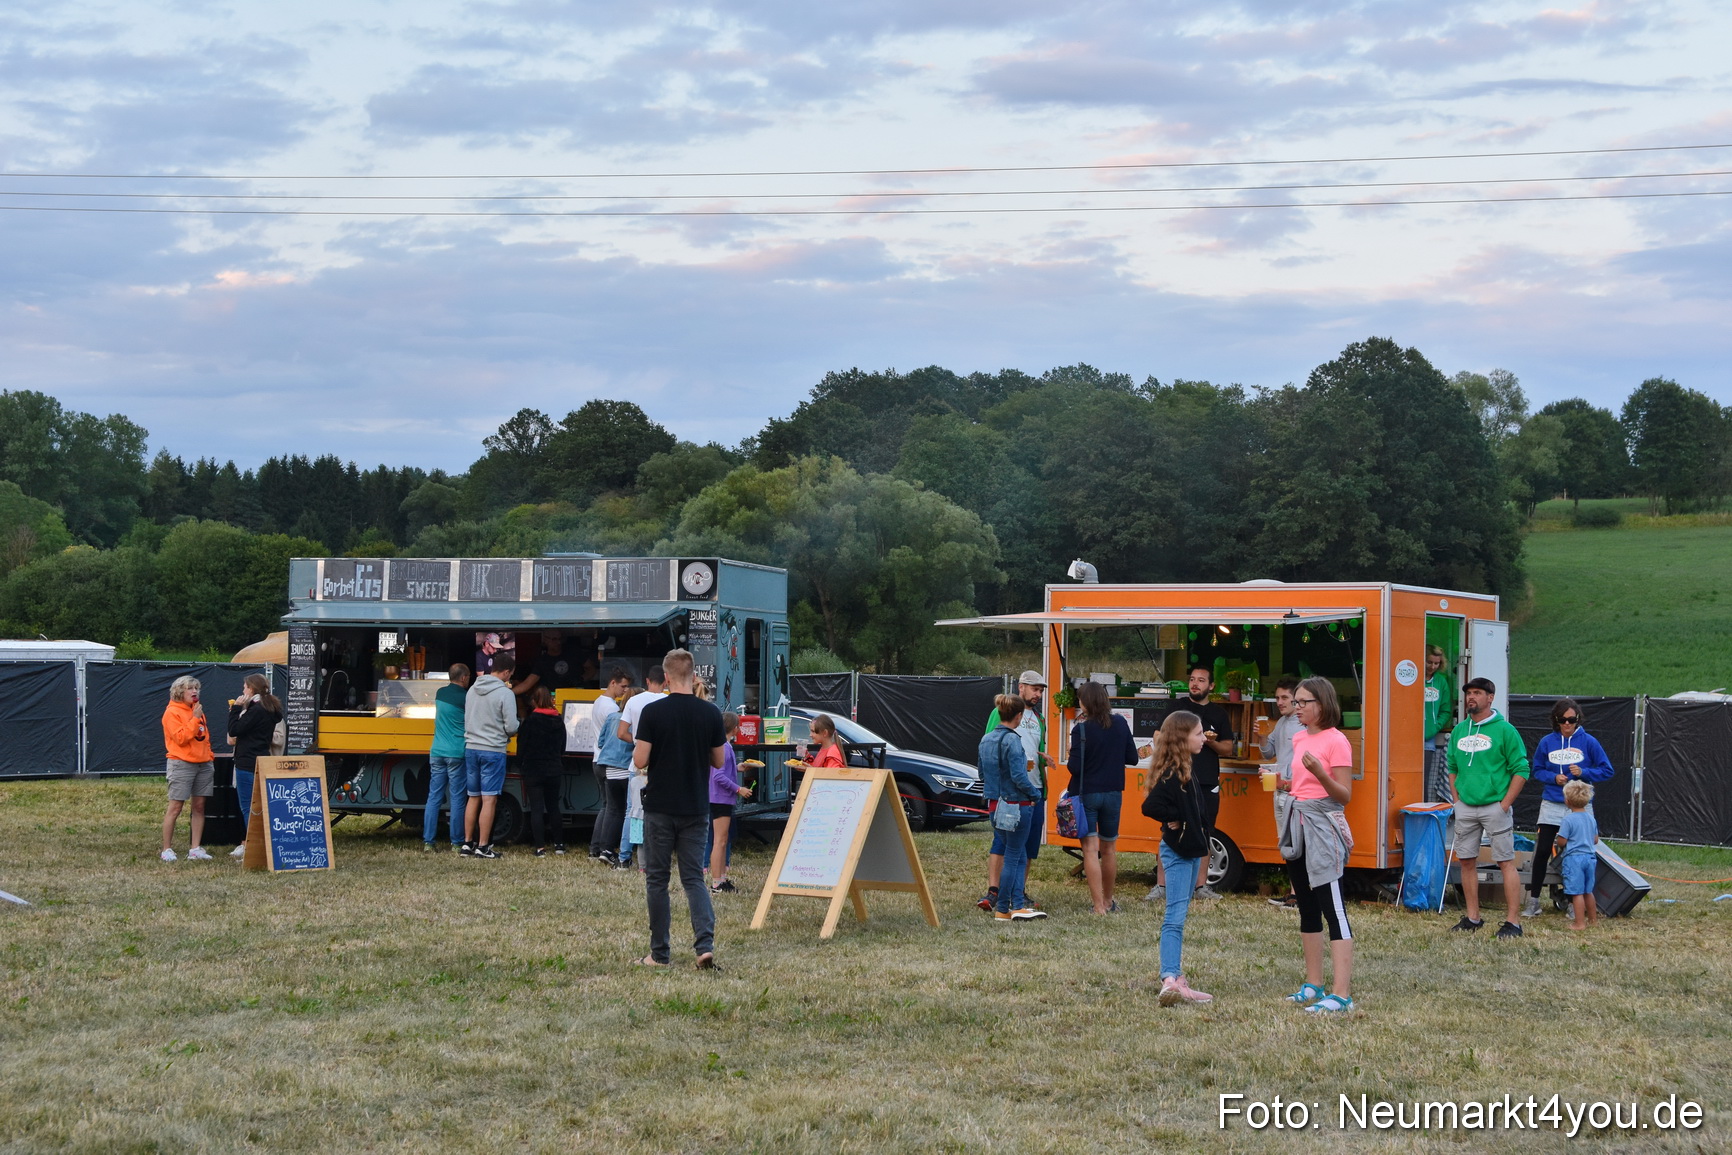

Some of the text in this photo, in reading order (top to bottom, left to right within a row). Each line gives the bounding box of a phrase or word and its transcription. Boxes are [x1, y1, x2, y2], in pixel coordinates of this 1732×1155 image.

[459, 563, 521, 599] BURGER
[534, 564, 592, 597] POMMES
[608, 562, 663, 599] SALAT
[690, 609, 717, 622] BURGER
[290, 643, 317, 656] BURGER
[694, 664, 709, 677] ALAT
[290, 679, 307, 690] SALAT
[276, 761, 309, 770] BIONADE
[268, 782, 297, 800] Volles
[286, 800, 323, 819] Programm
[311, 832, 324, 844] Eis
[277, 845, 305, 857] Pommes
